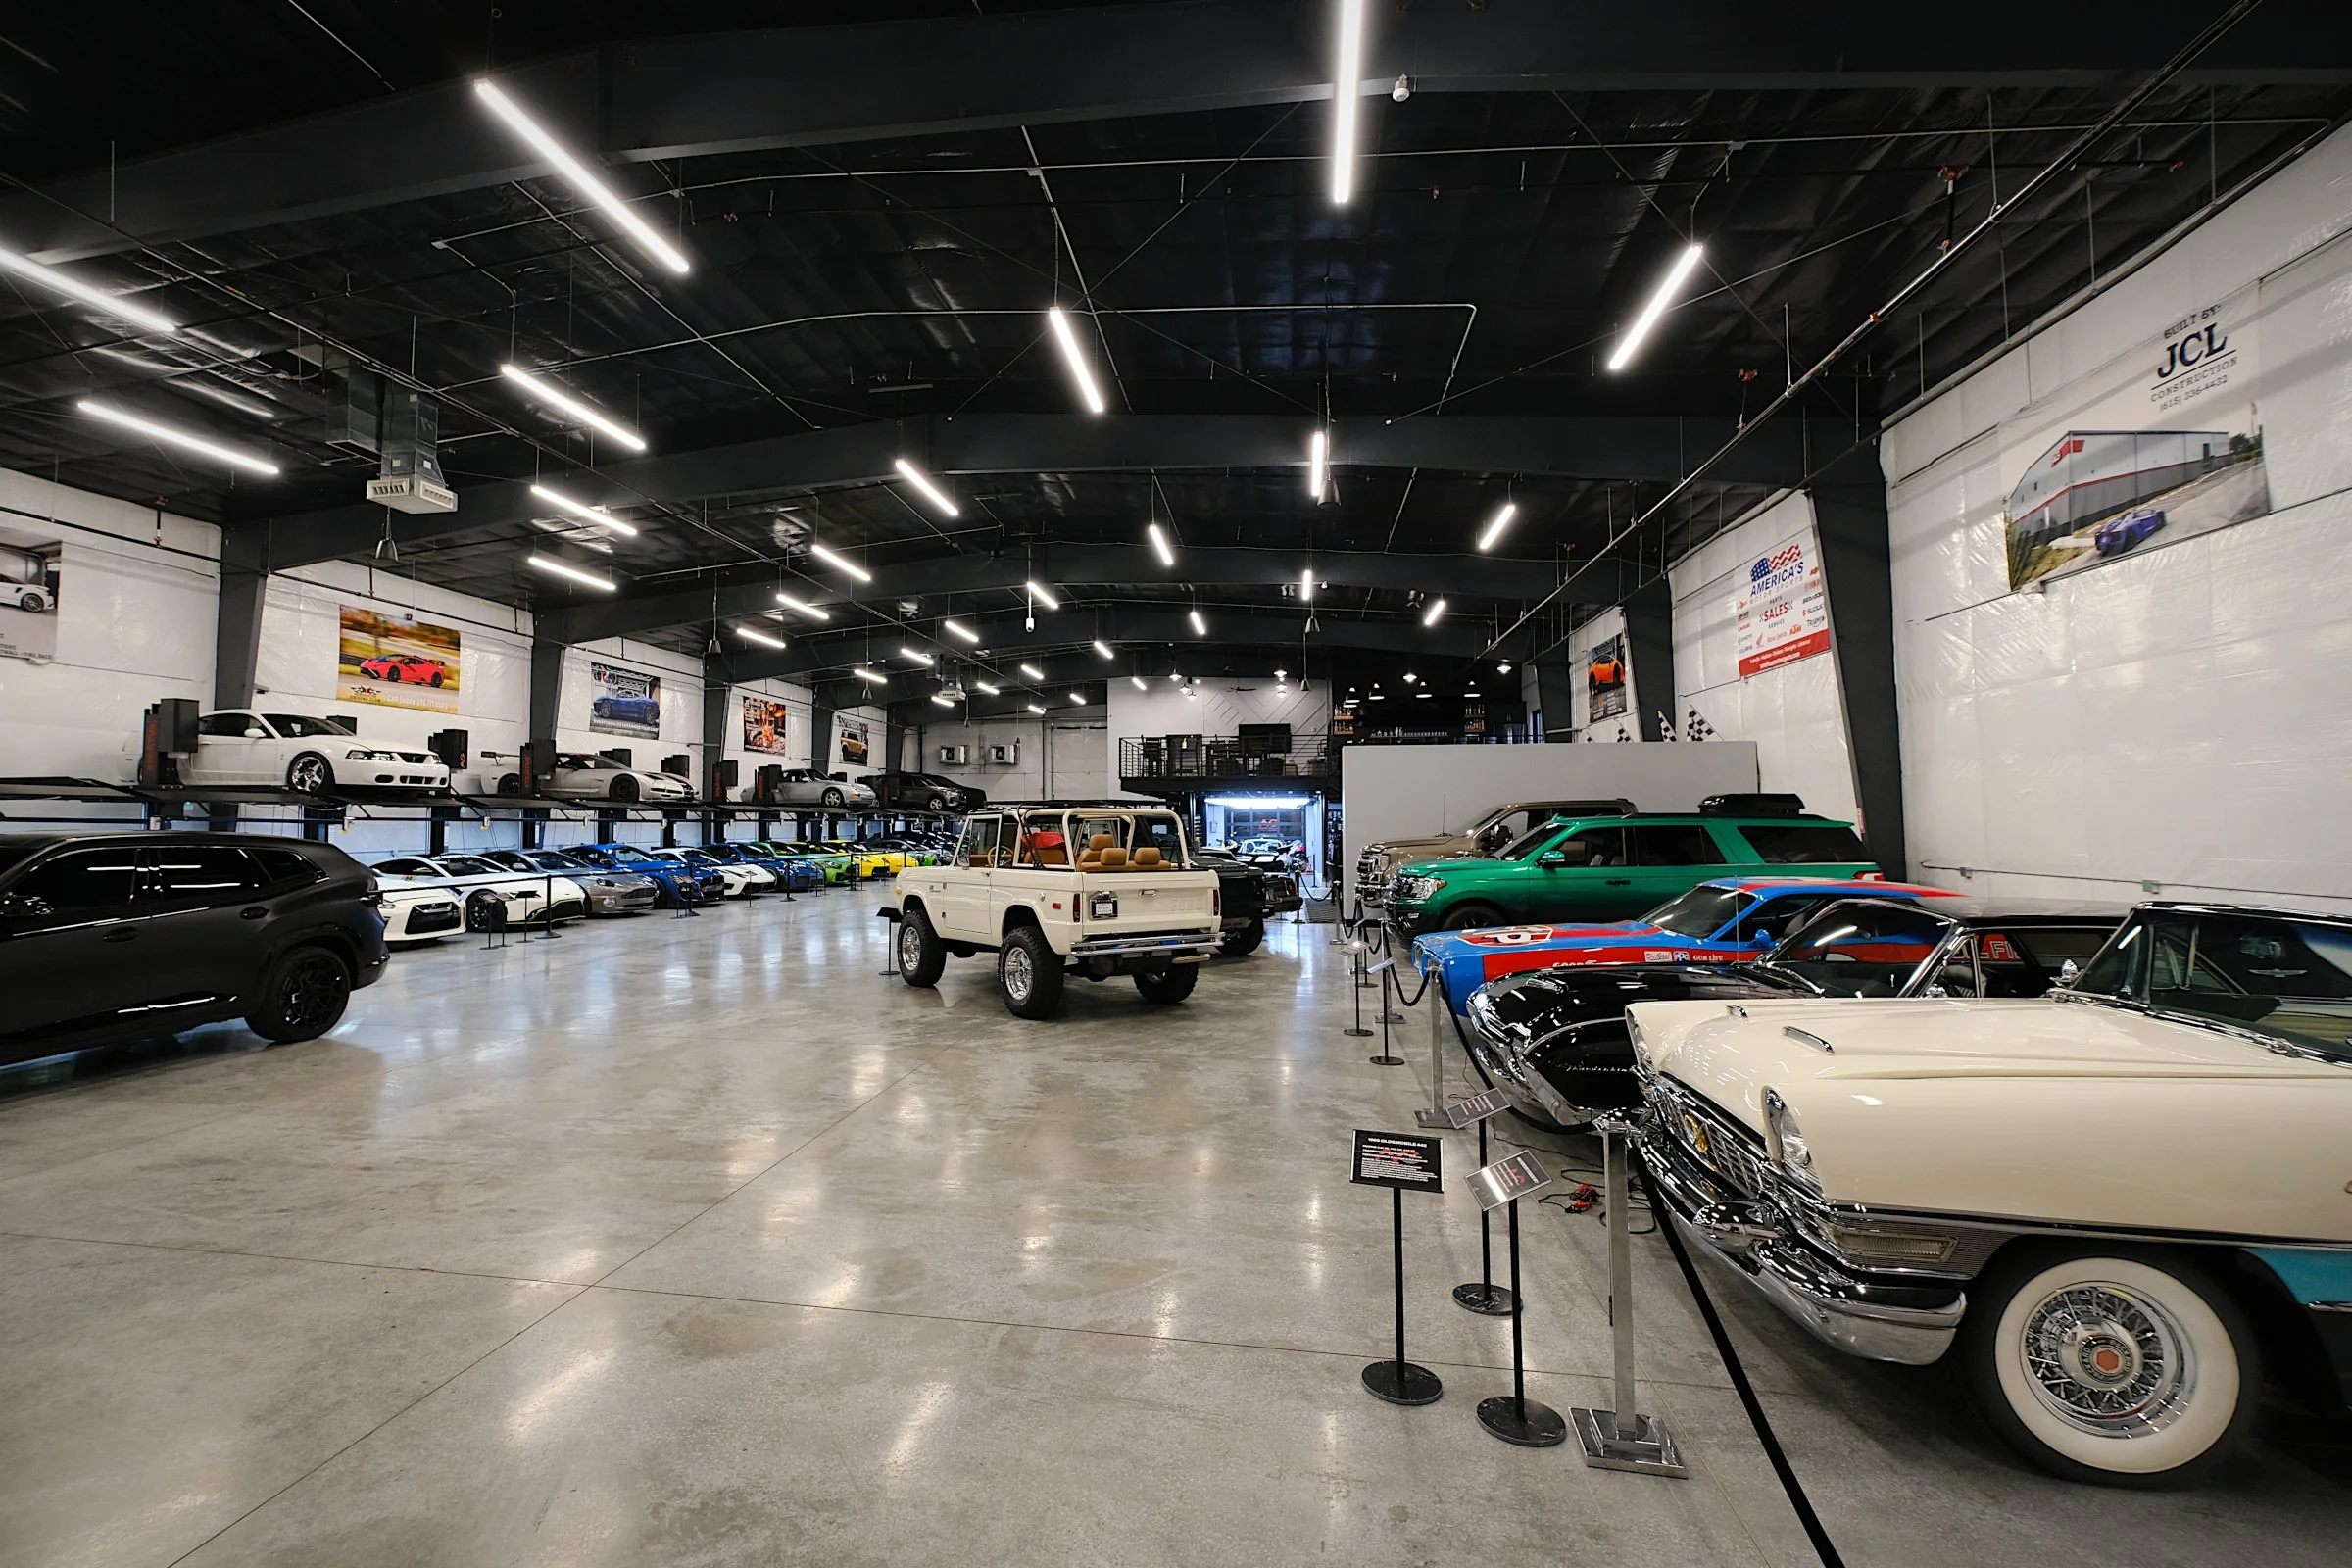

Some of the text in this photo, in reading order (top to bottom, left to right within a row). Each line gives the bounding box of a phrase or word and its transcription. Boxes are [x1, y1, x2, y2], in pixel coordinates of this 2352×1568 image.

[2164, 314, 2197, 339] BUILT
[2158, 322, 2229, 378] JCL
[2151, 357, 2237, 402] CONSTRUCTION
[1750, 561, 1804, 598] AMERICA'S
[1750, 591, 1772, 605] MOTOR
[1776, 576, 1803, 593] SPORTS
[1764, 602, 1788, 622] SALES
[1674, 952, 1690, 962] PPG
